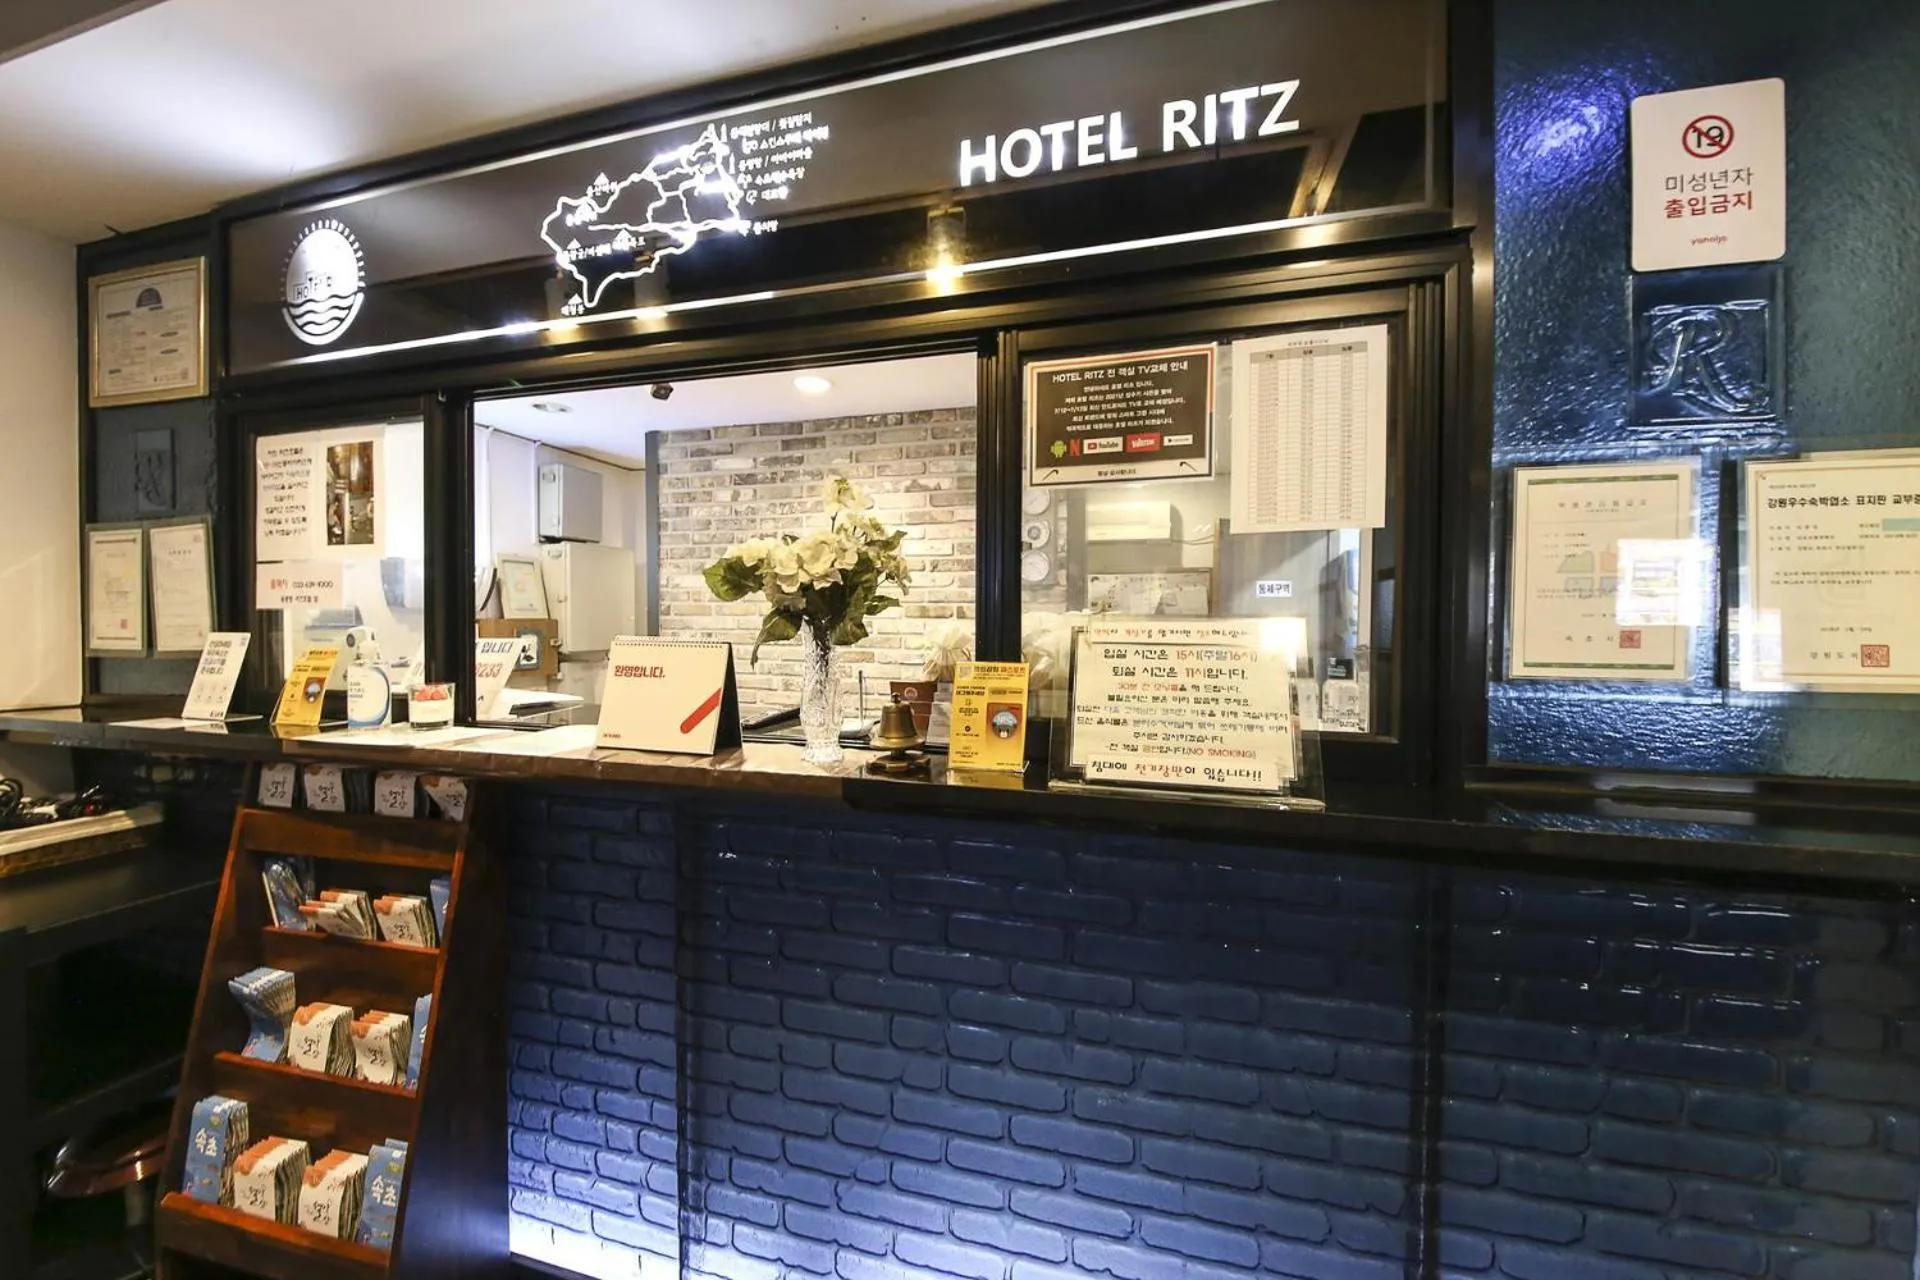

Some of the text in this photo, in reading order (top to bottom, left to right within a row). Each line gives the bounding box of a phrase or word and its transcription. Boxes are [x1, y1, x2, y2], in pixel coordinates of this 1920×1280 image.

[960, 79, 1301, 187] HOTEL RITZ
[1665, 167, 1754, 193] 미성년자
[1664, 191, 1754, 219] 출입금지
[1052, 371, 1083, 383] HOTEL
[1084, 369, 1105, 380] RITZ
[1118, 366, 1135, 376] 객실
[1137, 363, 1168, 374] TV교체
[1170, 361, 1189, 372] 안내
[1767, 496, 1850, 509] 강원우수숙박업소
[1855, 495, 1886, 506] 표지판
[1258, 583, 1290, 595] 통제구역
[481, 642, 513, 654] 입니다
[1104, 648, 1127, 660] 입실
[1134, 649, 1168, 660] 시간은
[1112, 666, 1248, 680] 퇴실 시간은 11시입니다.
[1092, 760, 1262, 783] 침대에 전기장판이 있습니다!!
[195, 1128, 218, 1158] 속초
[371, 1175, 397, 1208] 속초
